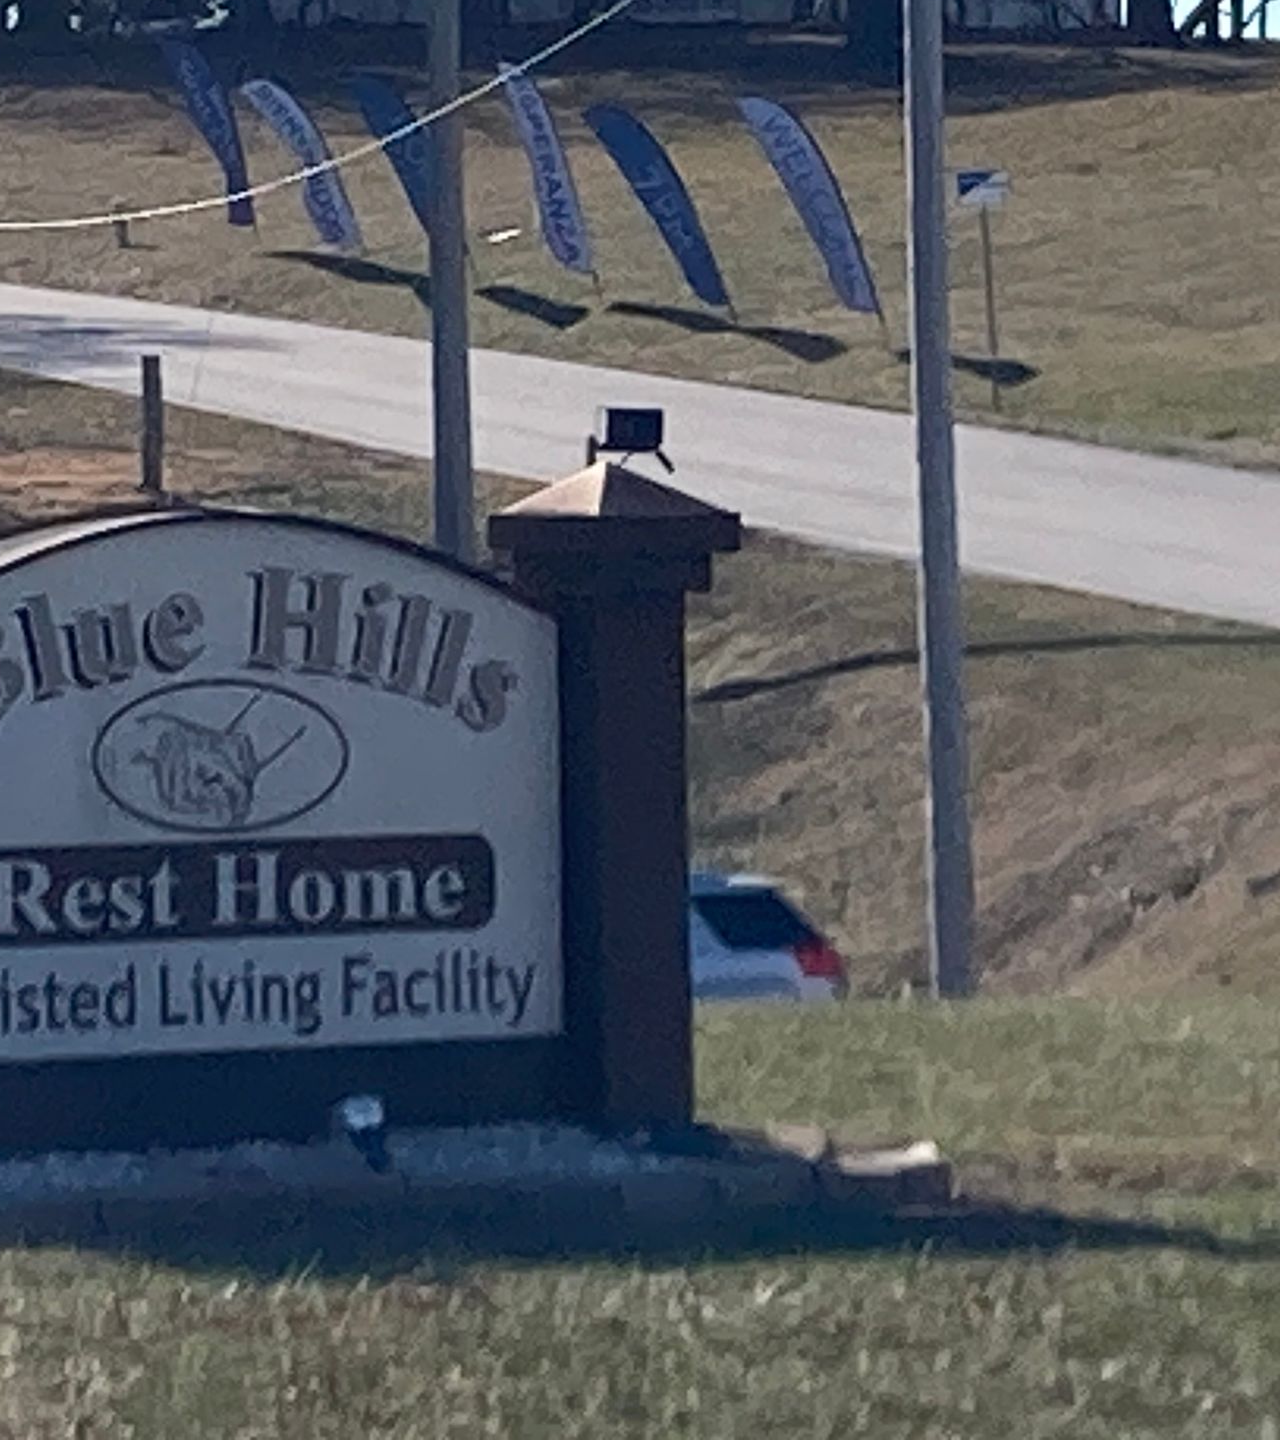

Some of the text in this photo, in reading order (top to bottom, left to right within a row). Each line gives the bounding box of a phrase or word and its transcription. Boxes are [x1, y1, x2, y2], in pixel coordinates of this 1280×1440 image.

[245, 566, 517, 734] Hills
[213, 850, 467, 926] Home
[159, 958, 321, 1035] Living
[340, 948, 536, 1027] Facility
